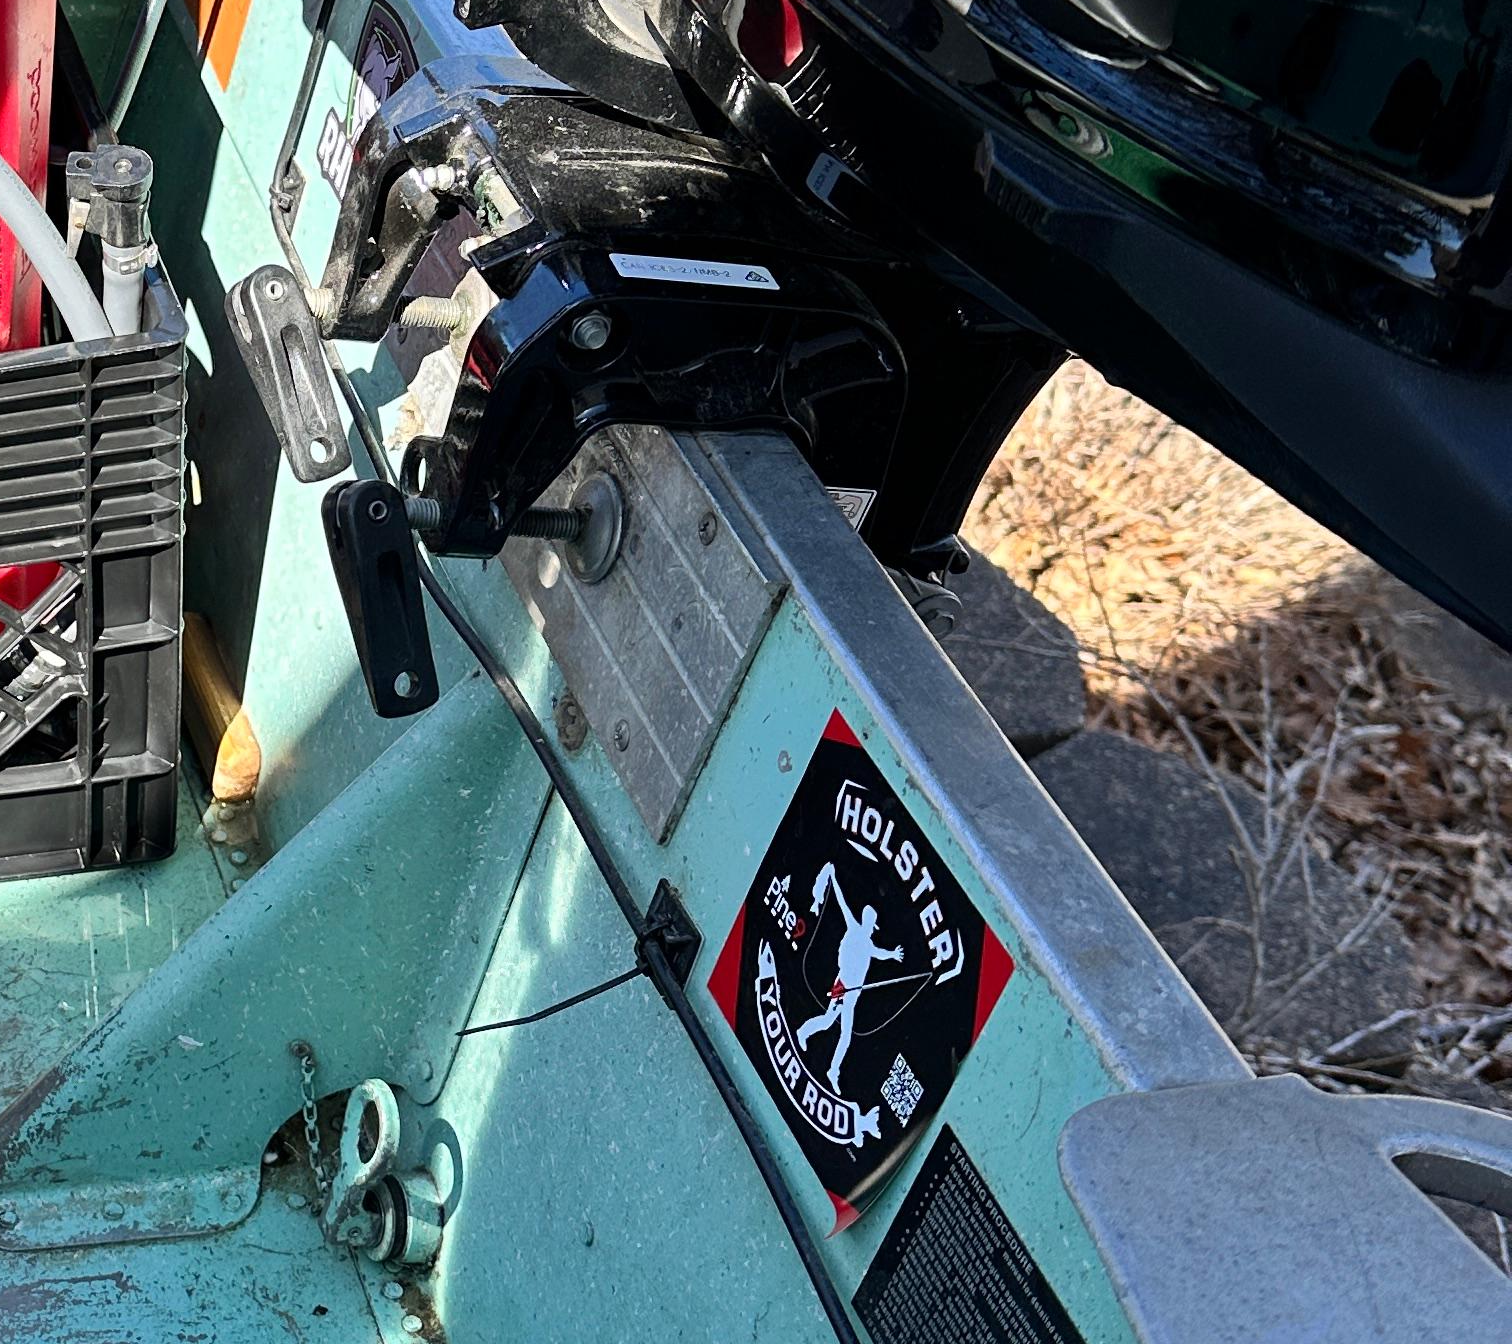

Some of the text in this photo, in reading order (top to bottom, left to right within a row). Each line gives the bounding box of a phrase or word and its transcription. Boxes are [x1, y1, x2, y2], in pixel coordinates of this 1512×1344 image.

[841, 793, 954, 969] HOLSTER
[761, 984, 849, 1136] YOUR ROD
[949, 1141, 1032, 1276] STARTING PROCEDURE
